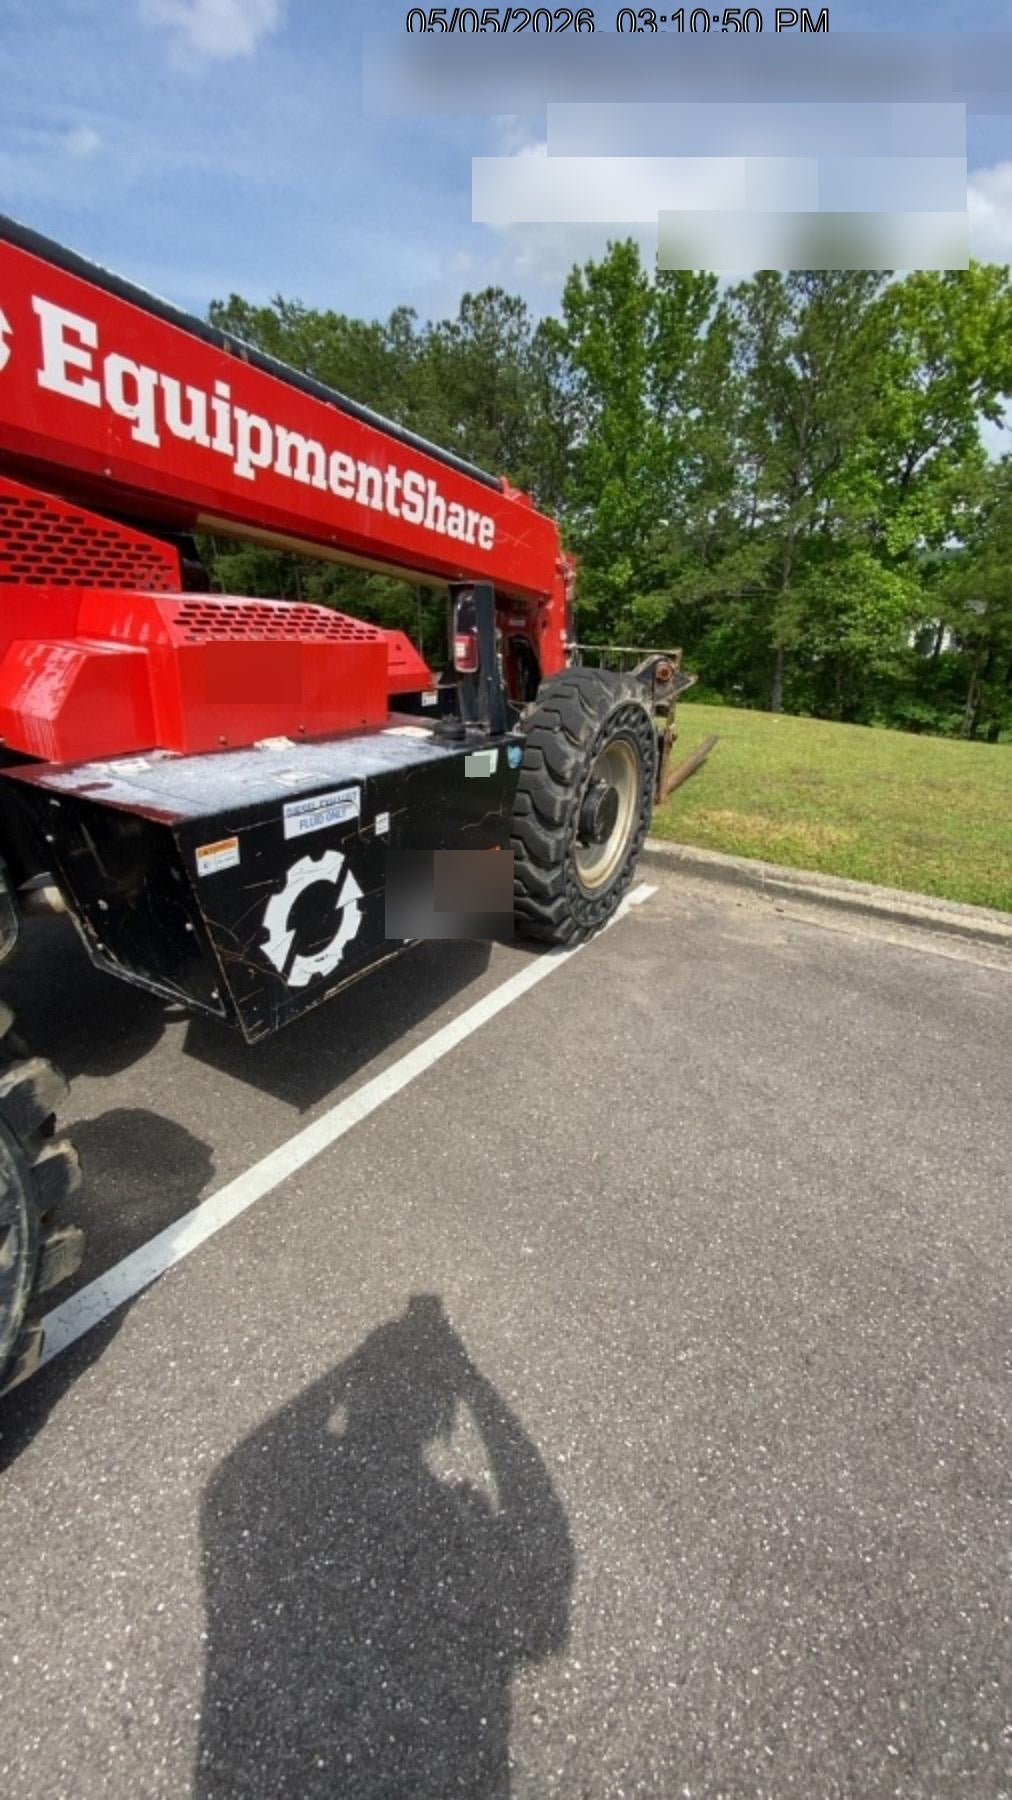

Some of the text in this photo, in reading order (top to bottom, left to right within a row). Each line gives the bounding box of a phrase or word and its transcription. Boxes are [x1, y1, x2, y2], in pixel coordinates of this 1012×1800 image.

[32, 295, 495, 551] EquipmentShare
[299, 806, 348, 831] FLUID ONLY
